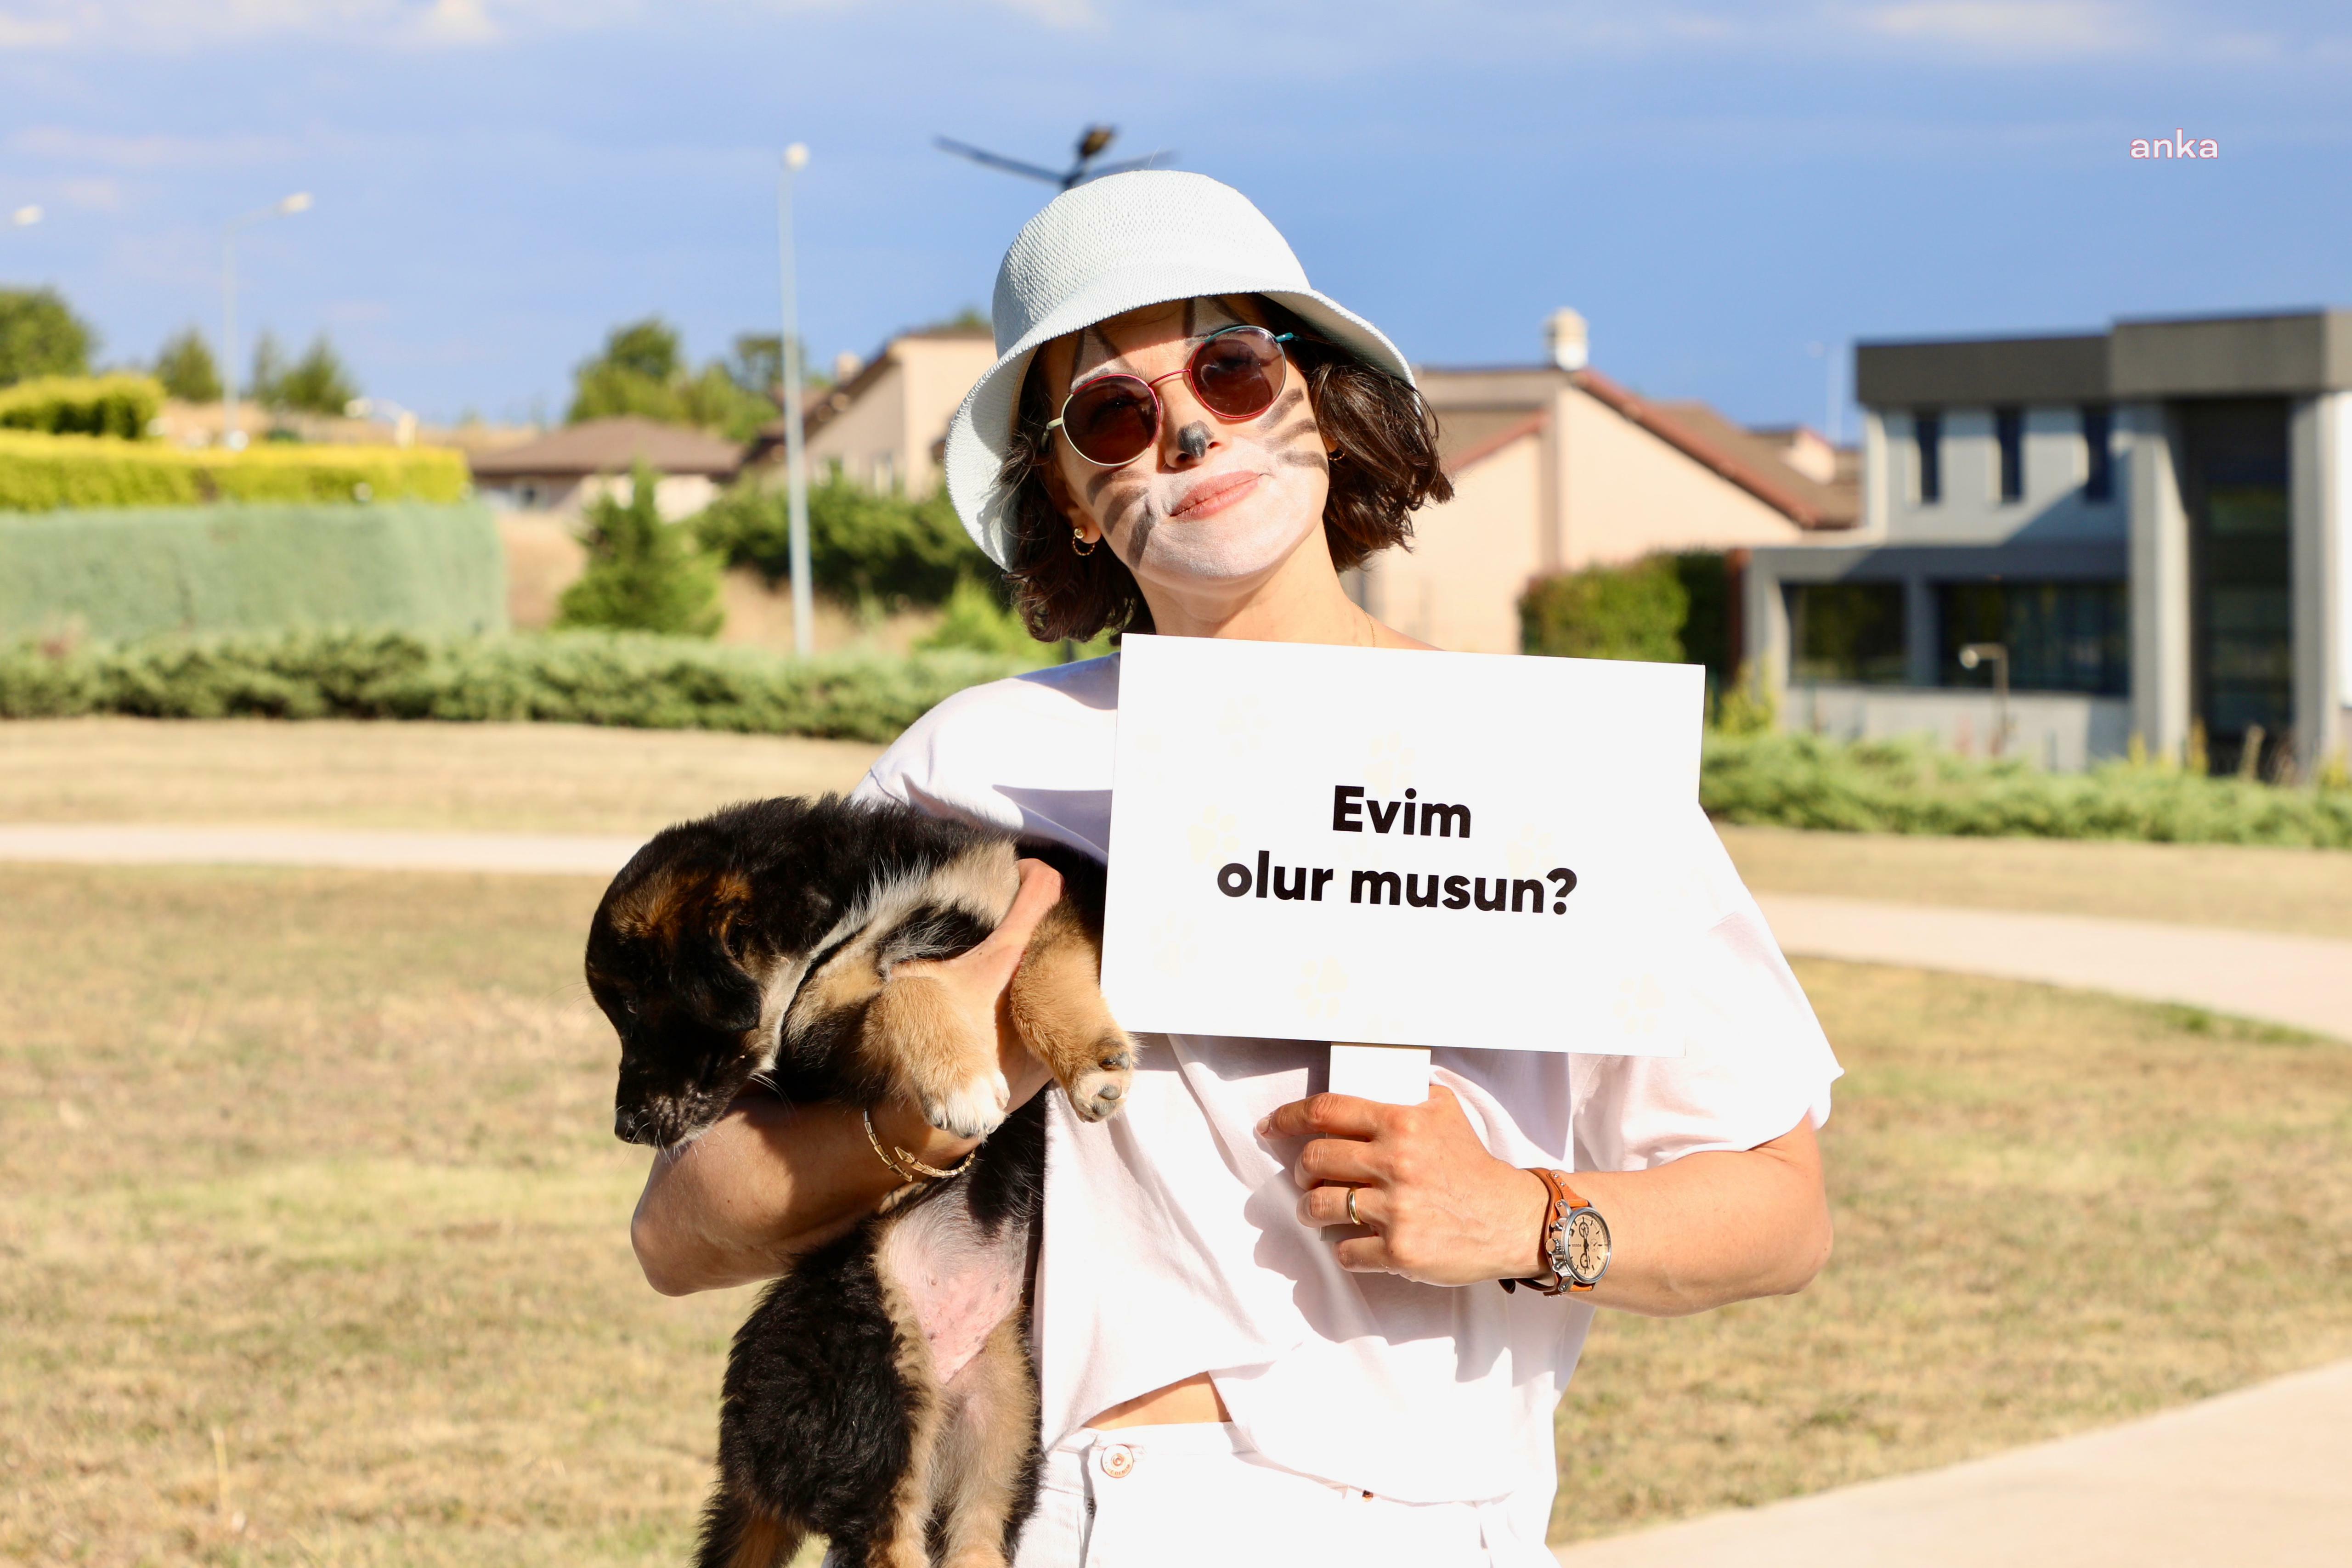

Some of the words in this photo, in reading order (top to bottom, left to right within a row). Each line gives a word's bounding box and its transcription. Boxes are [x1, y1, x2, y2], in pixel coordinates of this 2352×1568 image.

[1333, 785, 1471, 838] Evim
[1217, 850, 1334, 901] olur
[1350, 868, 1577, 915] musun?
